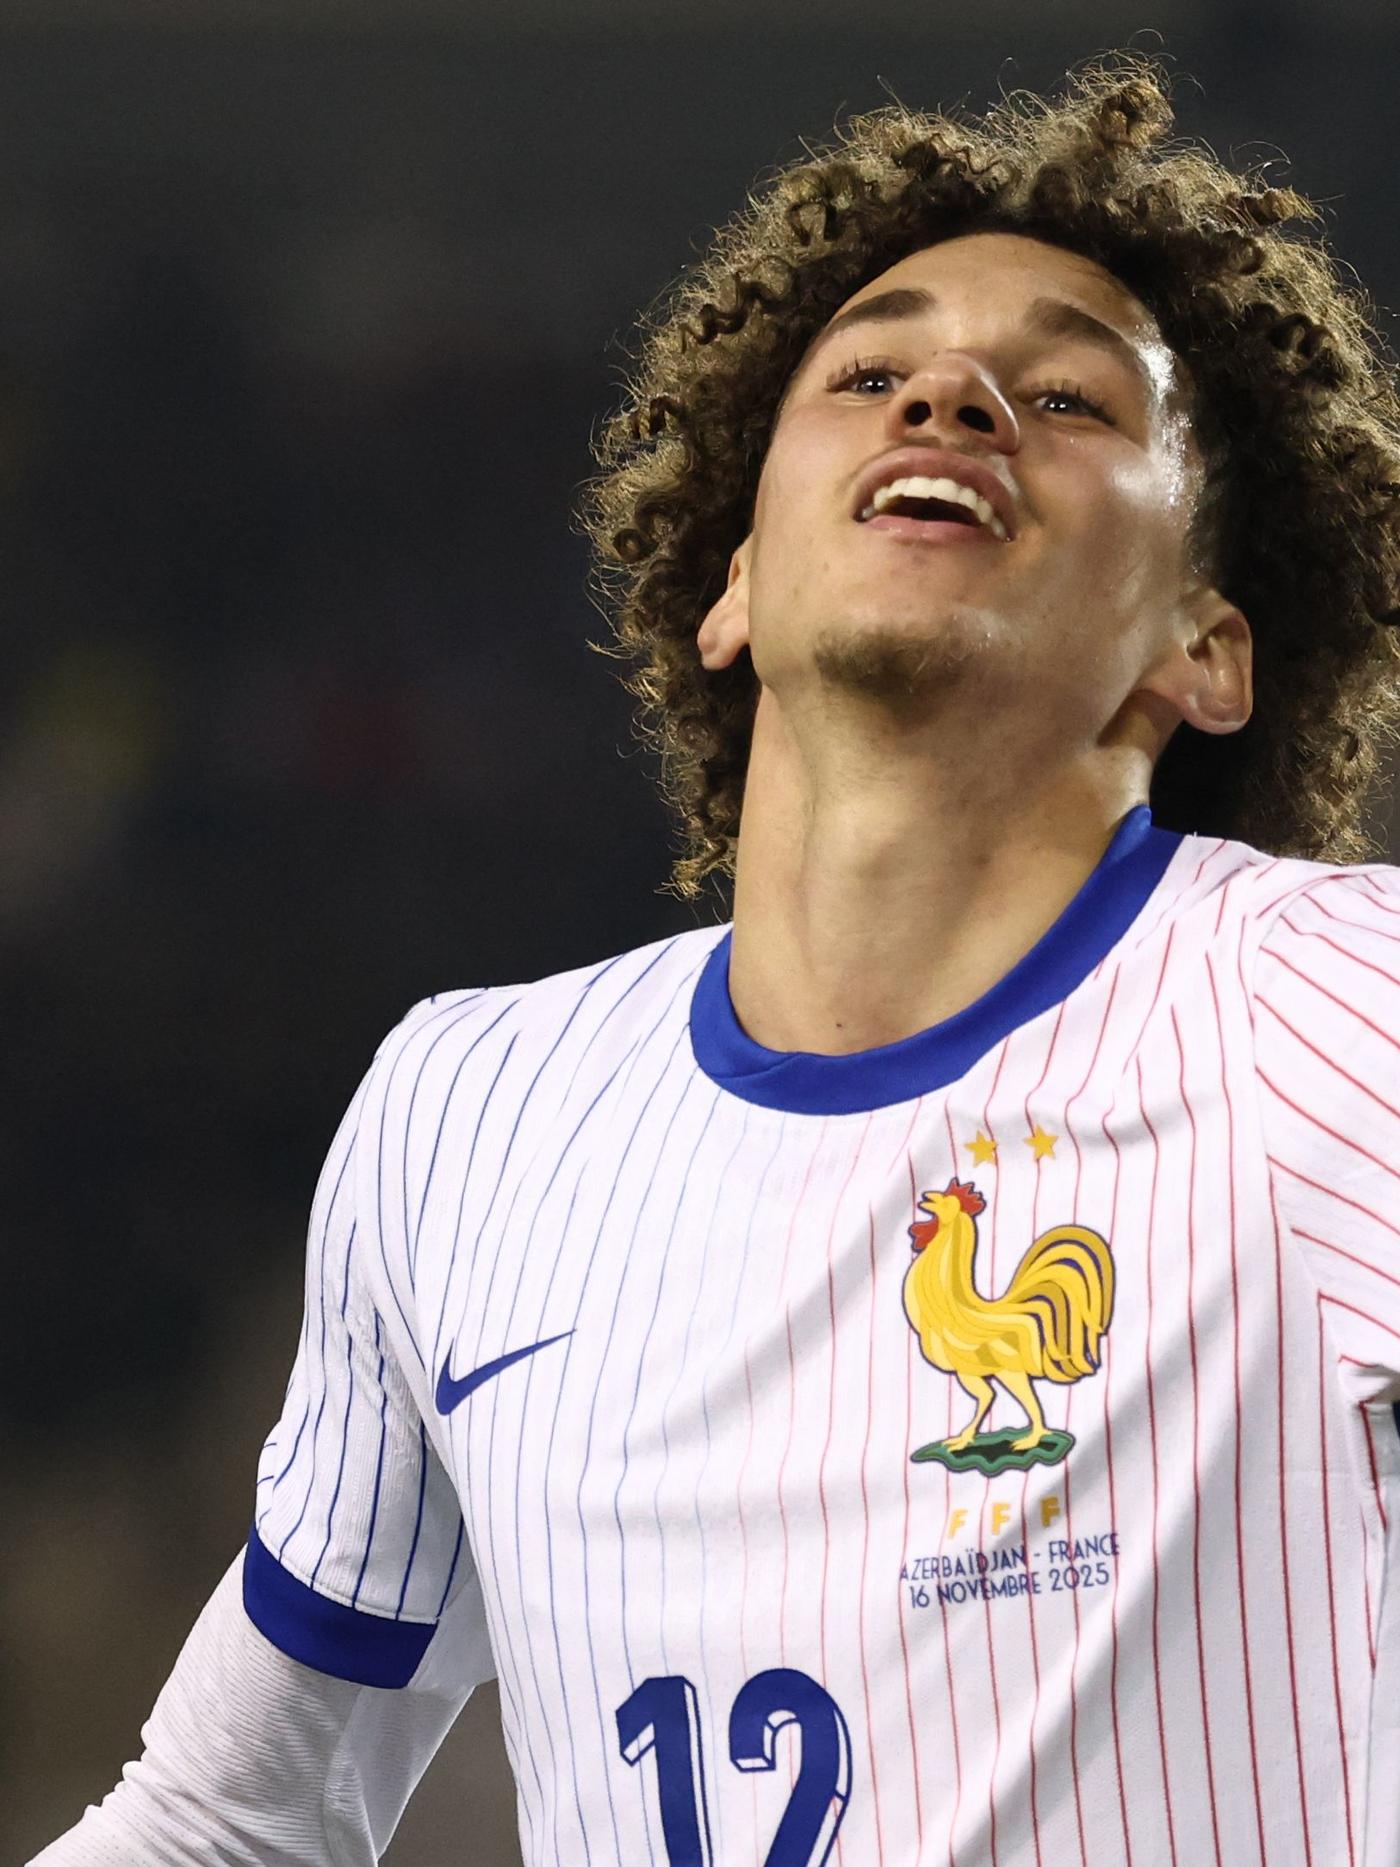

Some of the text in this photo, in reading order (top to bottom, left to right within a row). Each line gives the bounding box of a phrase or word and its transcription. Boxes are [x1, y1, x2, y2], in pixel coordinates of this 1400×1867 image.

[900, 1547, 1028, 1582] AZERBAÏDJAN
[1048, 1533, 1120, 1564] FRANCE
[909, 1562, 1110, 1609] 16 NOVEMBRE 2025
[615, 1667, 853, 1867] 12
